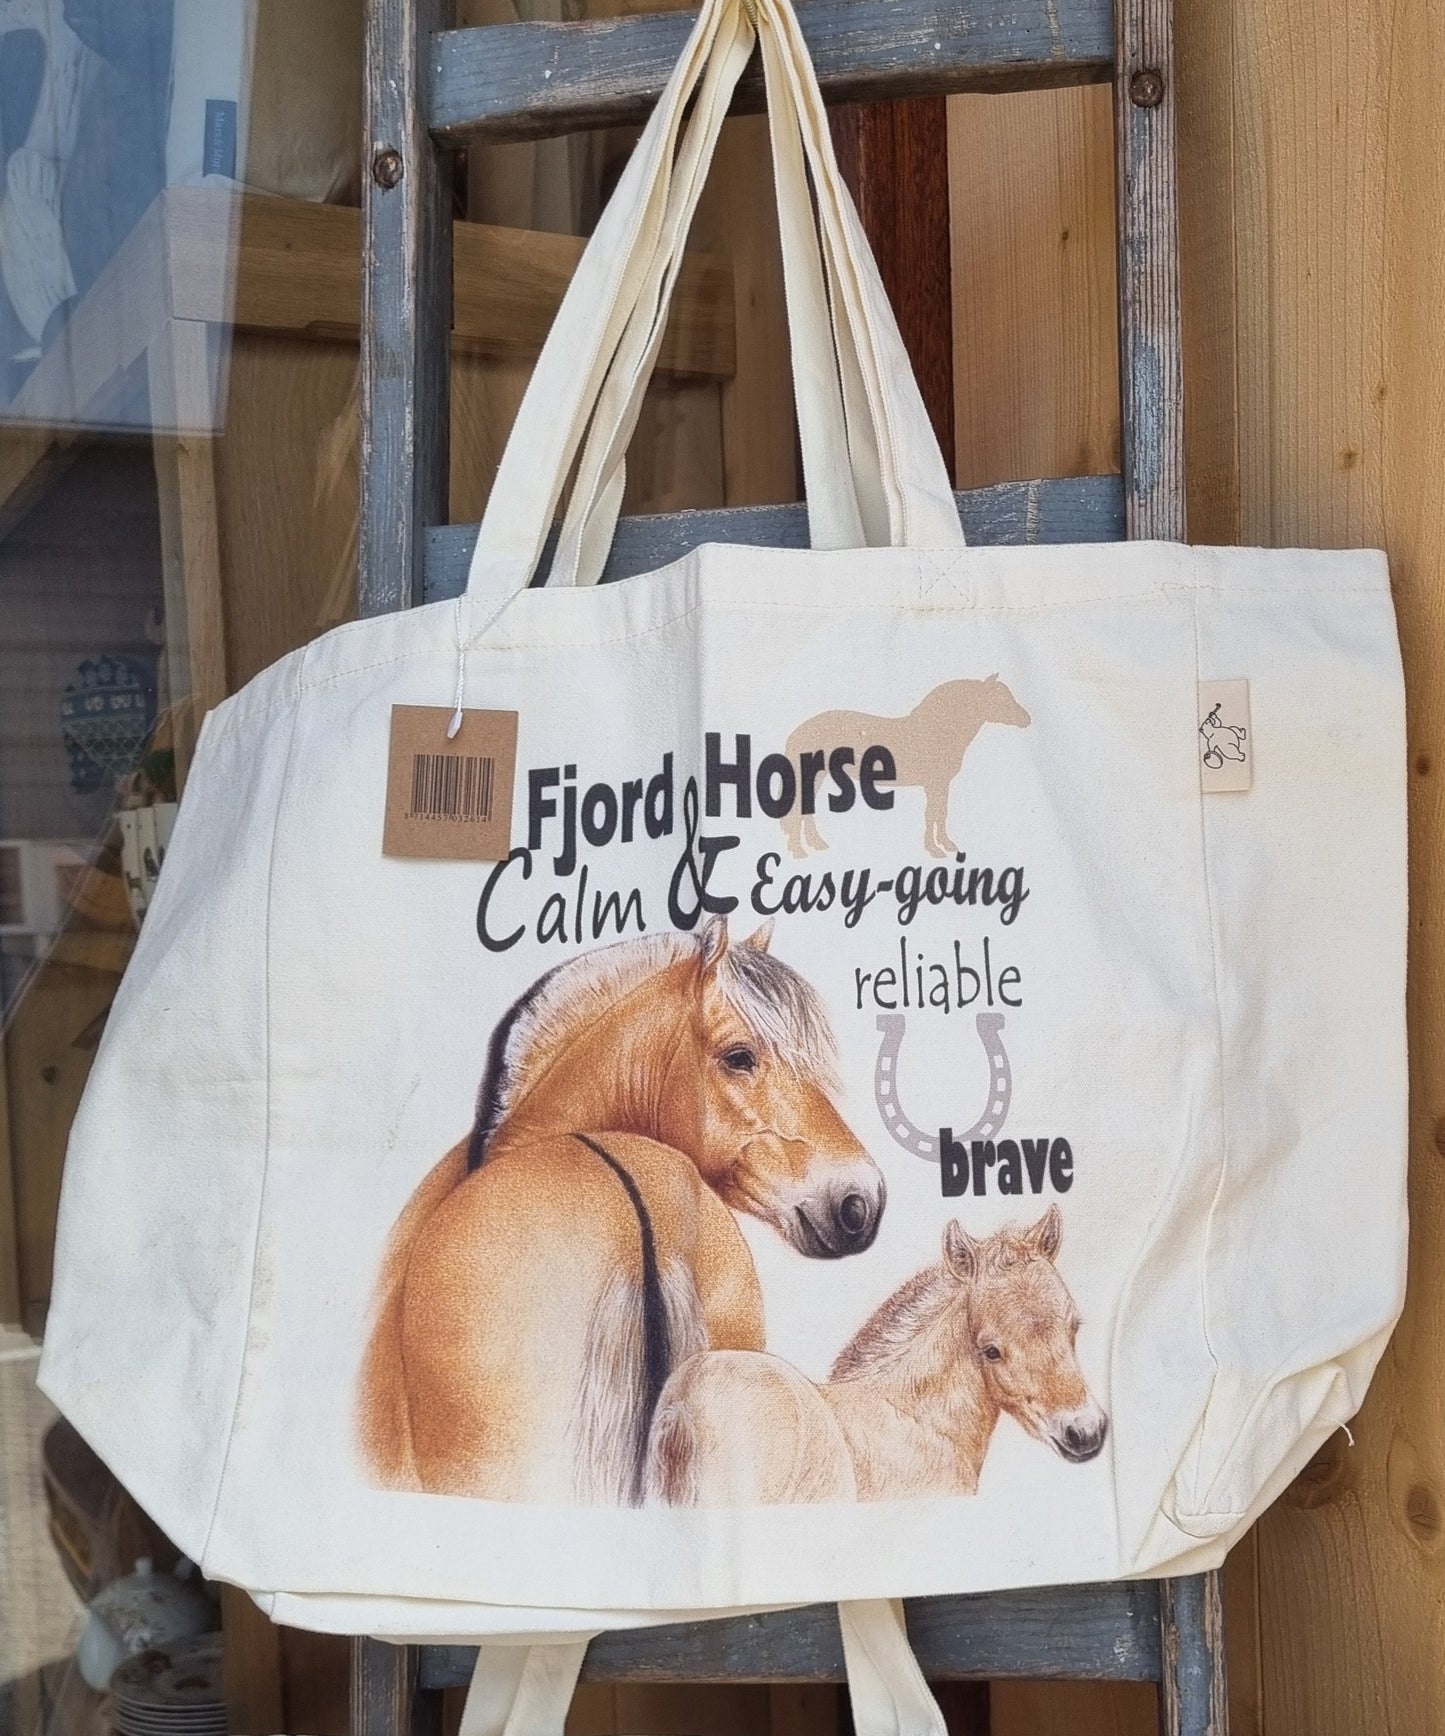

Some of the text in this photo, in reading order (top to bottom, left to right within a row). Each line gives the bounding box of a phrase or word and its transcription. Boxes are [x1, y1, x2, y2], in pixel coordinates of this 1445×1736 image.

[528, 732, 897, 876] Fjord Horse
[476, 776, 1030, 952] Calm & Easy-going
[854, 936, 1023, 1014] reliable
[939, 1127, 1074, 1198] brave
